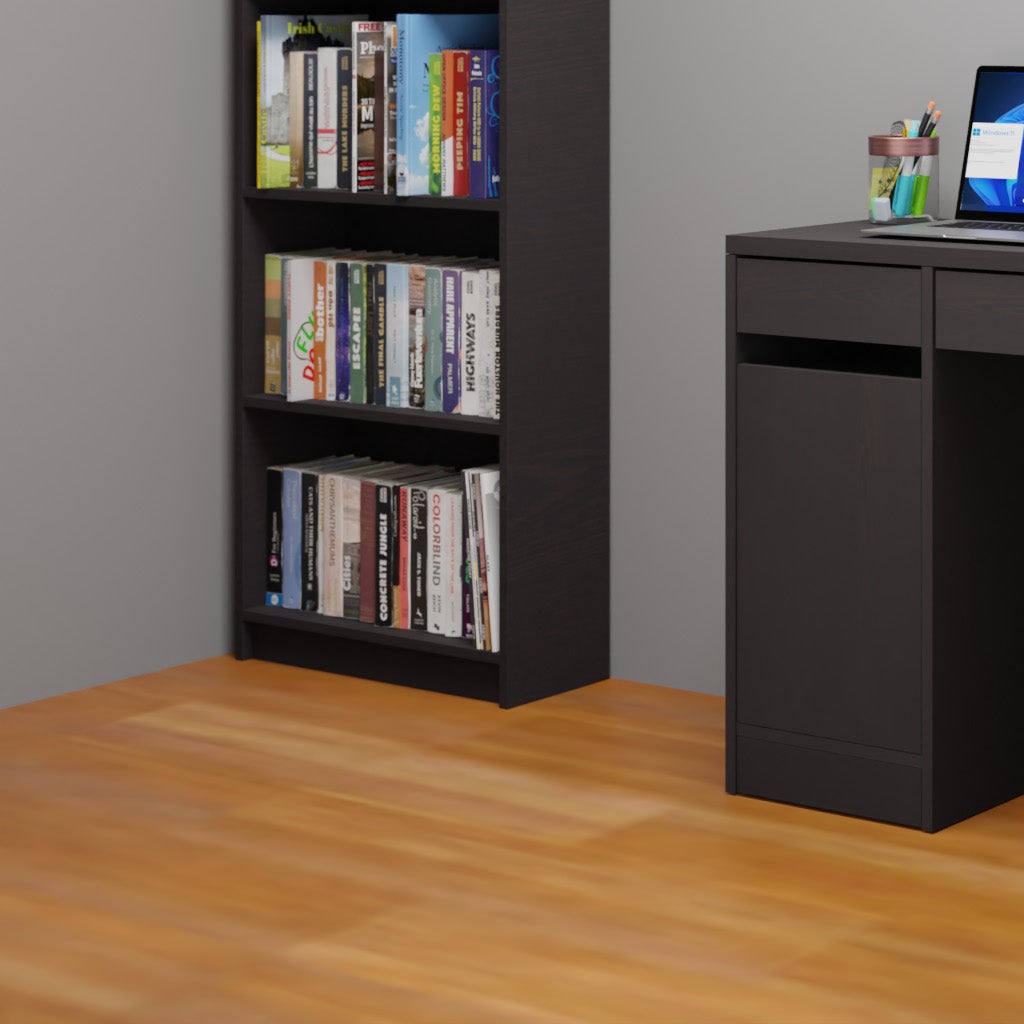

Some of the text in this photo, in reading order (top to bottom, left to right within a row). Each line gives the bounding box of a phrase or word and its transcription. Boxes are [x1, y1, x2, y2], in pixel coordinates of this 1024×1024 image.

[287, 22, 316, 34] Irish
[358, 23, 381, 31] FREE
[432, 84, 441, 174] MORNING DEW
[456, 91, 464, 171] PEEPING TIM
[446, 276, 455, 302] HARE
[352, 307, 361, 370] ESCAPEE
[377, 297, 385, 388] THE FINAL GAMBLE
[446, 303, 455, 355] APPARENT
[466, 313, 475, 392] HIGHWAYS
[328, 477, 336, 567] CHRYSANTHEMUMS
[432, 493, 441, 586] COLORBLIND
[379, 513, 388, 622] CONCRETE JUNGLE
